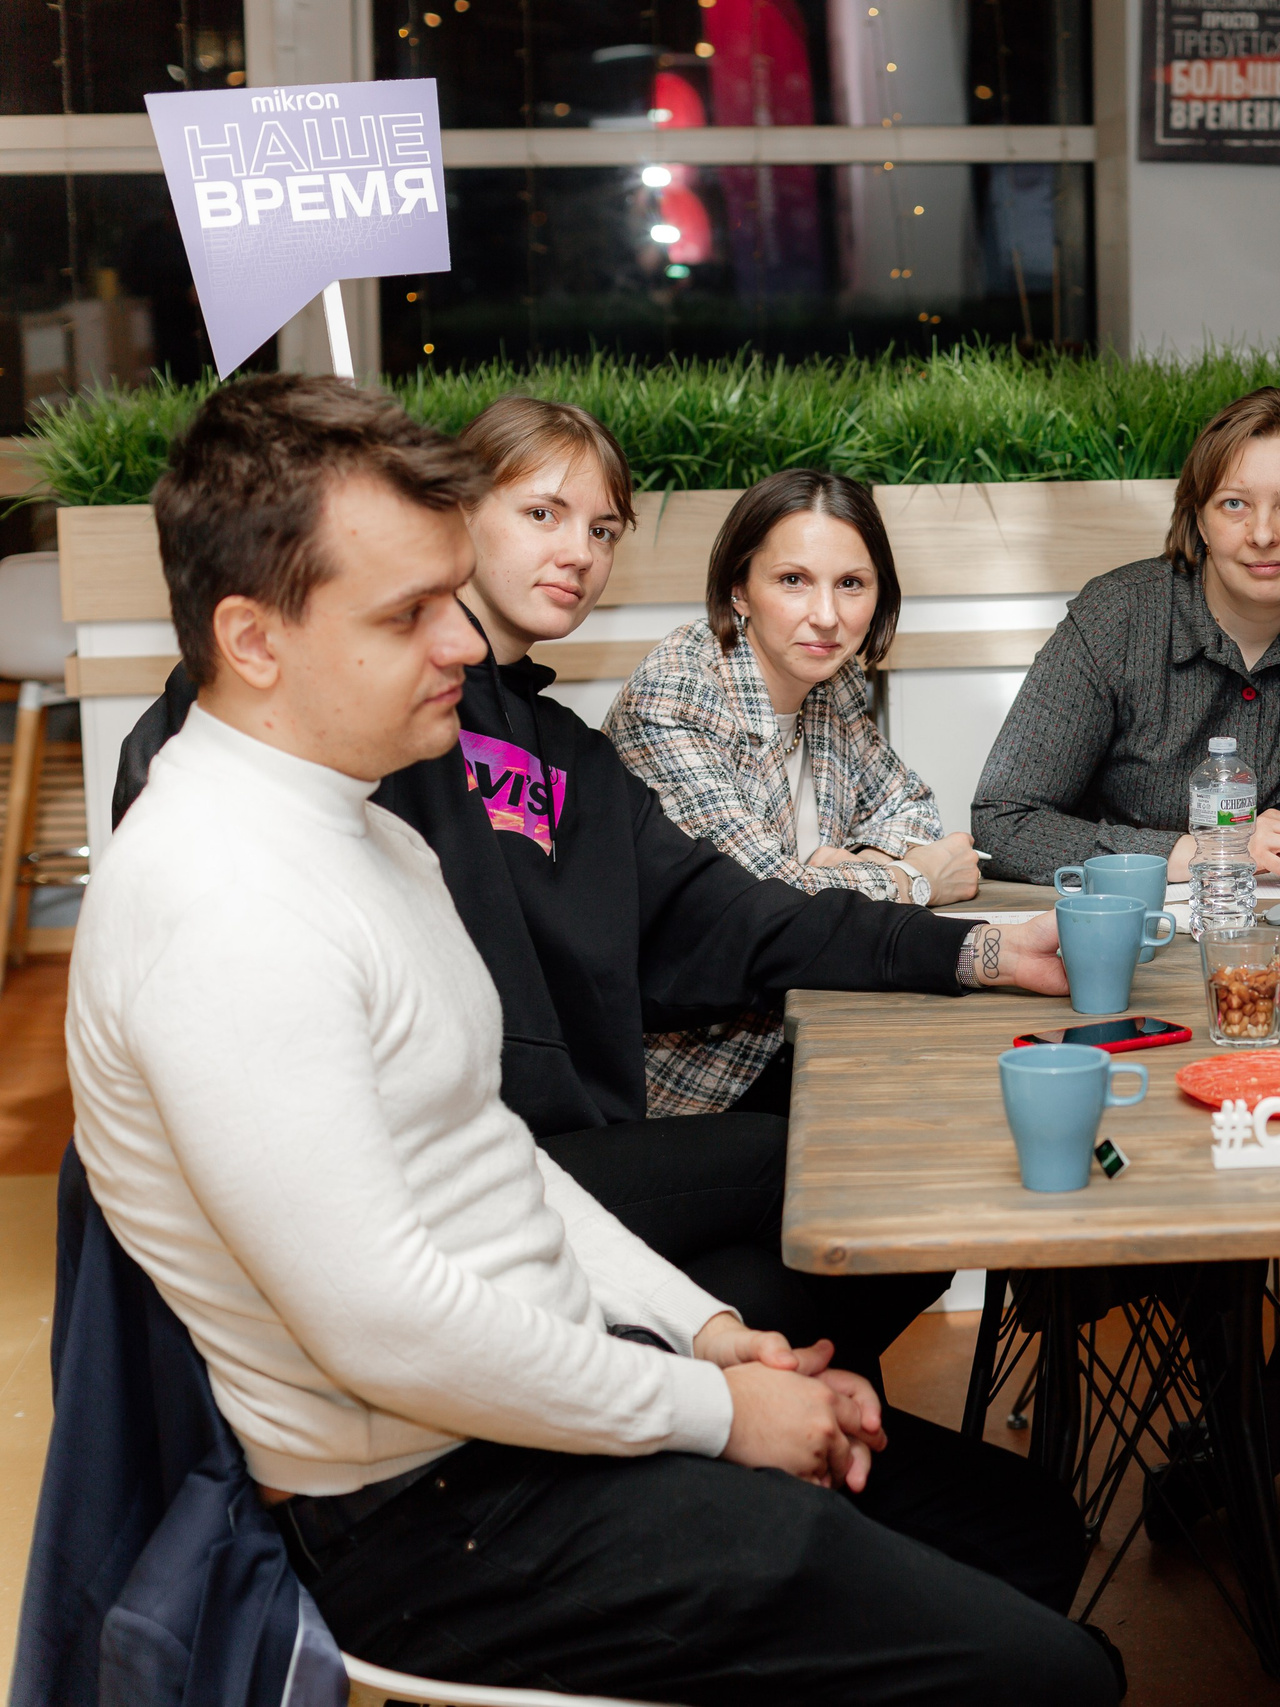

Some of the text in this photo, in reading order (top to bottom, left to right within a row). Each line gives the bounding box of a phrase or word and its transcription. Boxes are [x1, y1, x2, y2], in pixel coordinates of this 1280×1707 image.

[251, 89, 340, 114] mikron
[184, 112, 432, 180] НАШЕ
[193, 167, 439, 229] ВРЕМЯ
